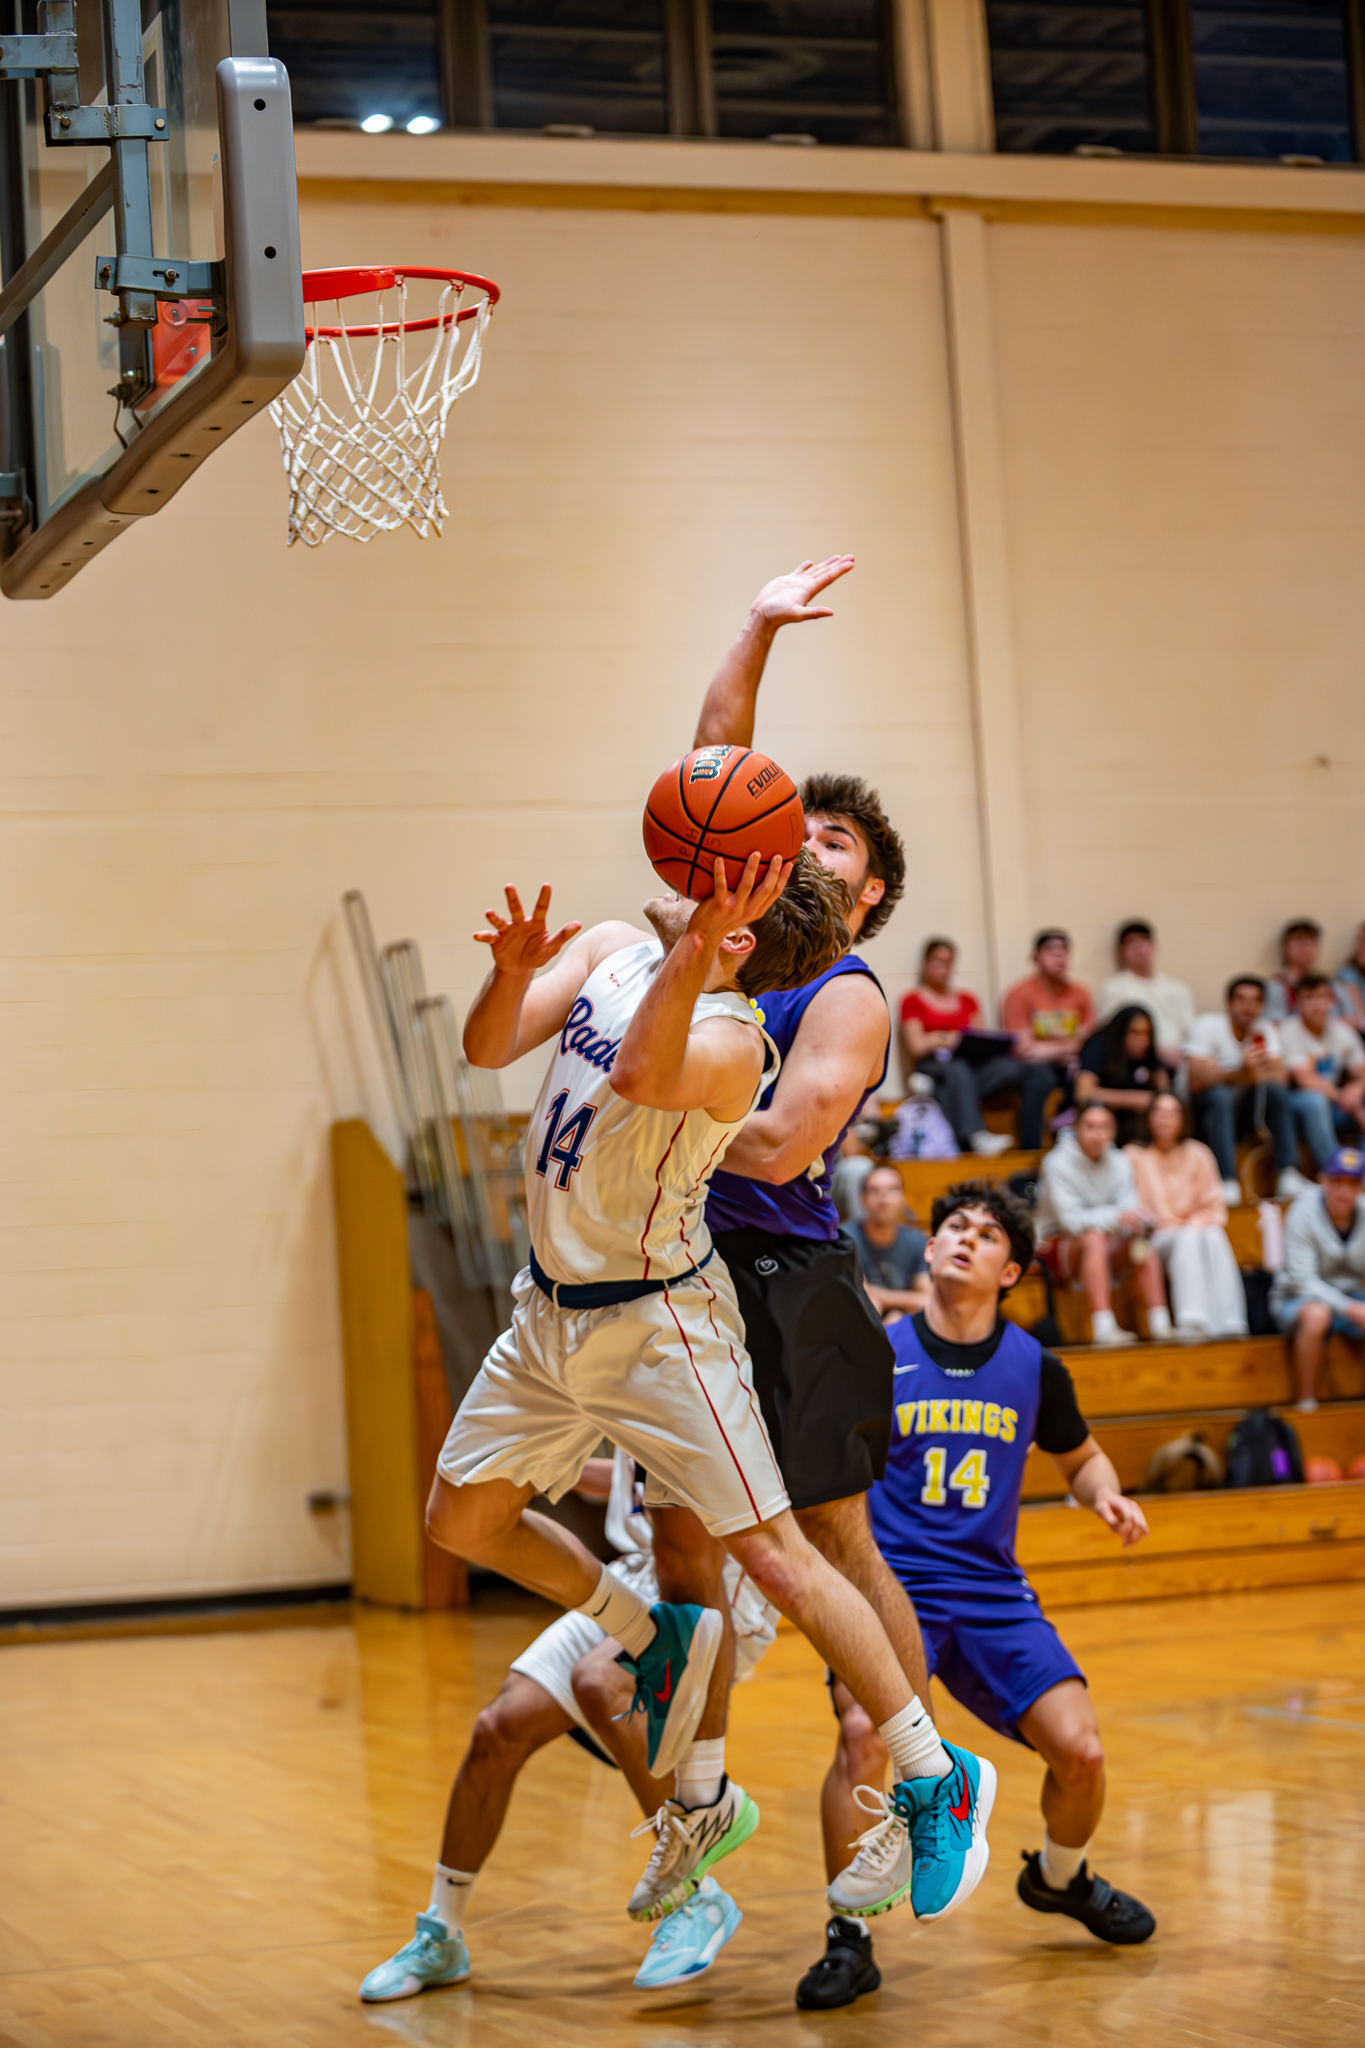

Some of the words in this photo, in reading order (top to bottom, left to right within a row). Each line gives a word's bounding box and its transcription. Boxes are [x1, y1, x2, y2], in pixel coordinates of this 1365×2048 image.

[536, 1088, 598, 1191] 14
[895, 1399, 1018, 1443] VIKINGS
[921, 1447, 990, 1509] 14
